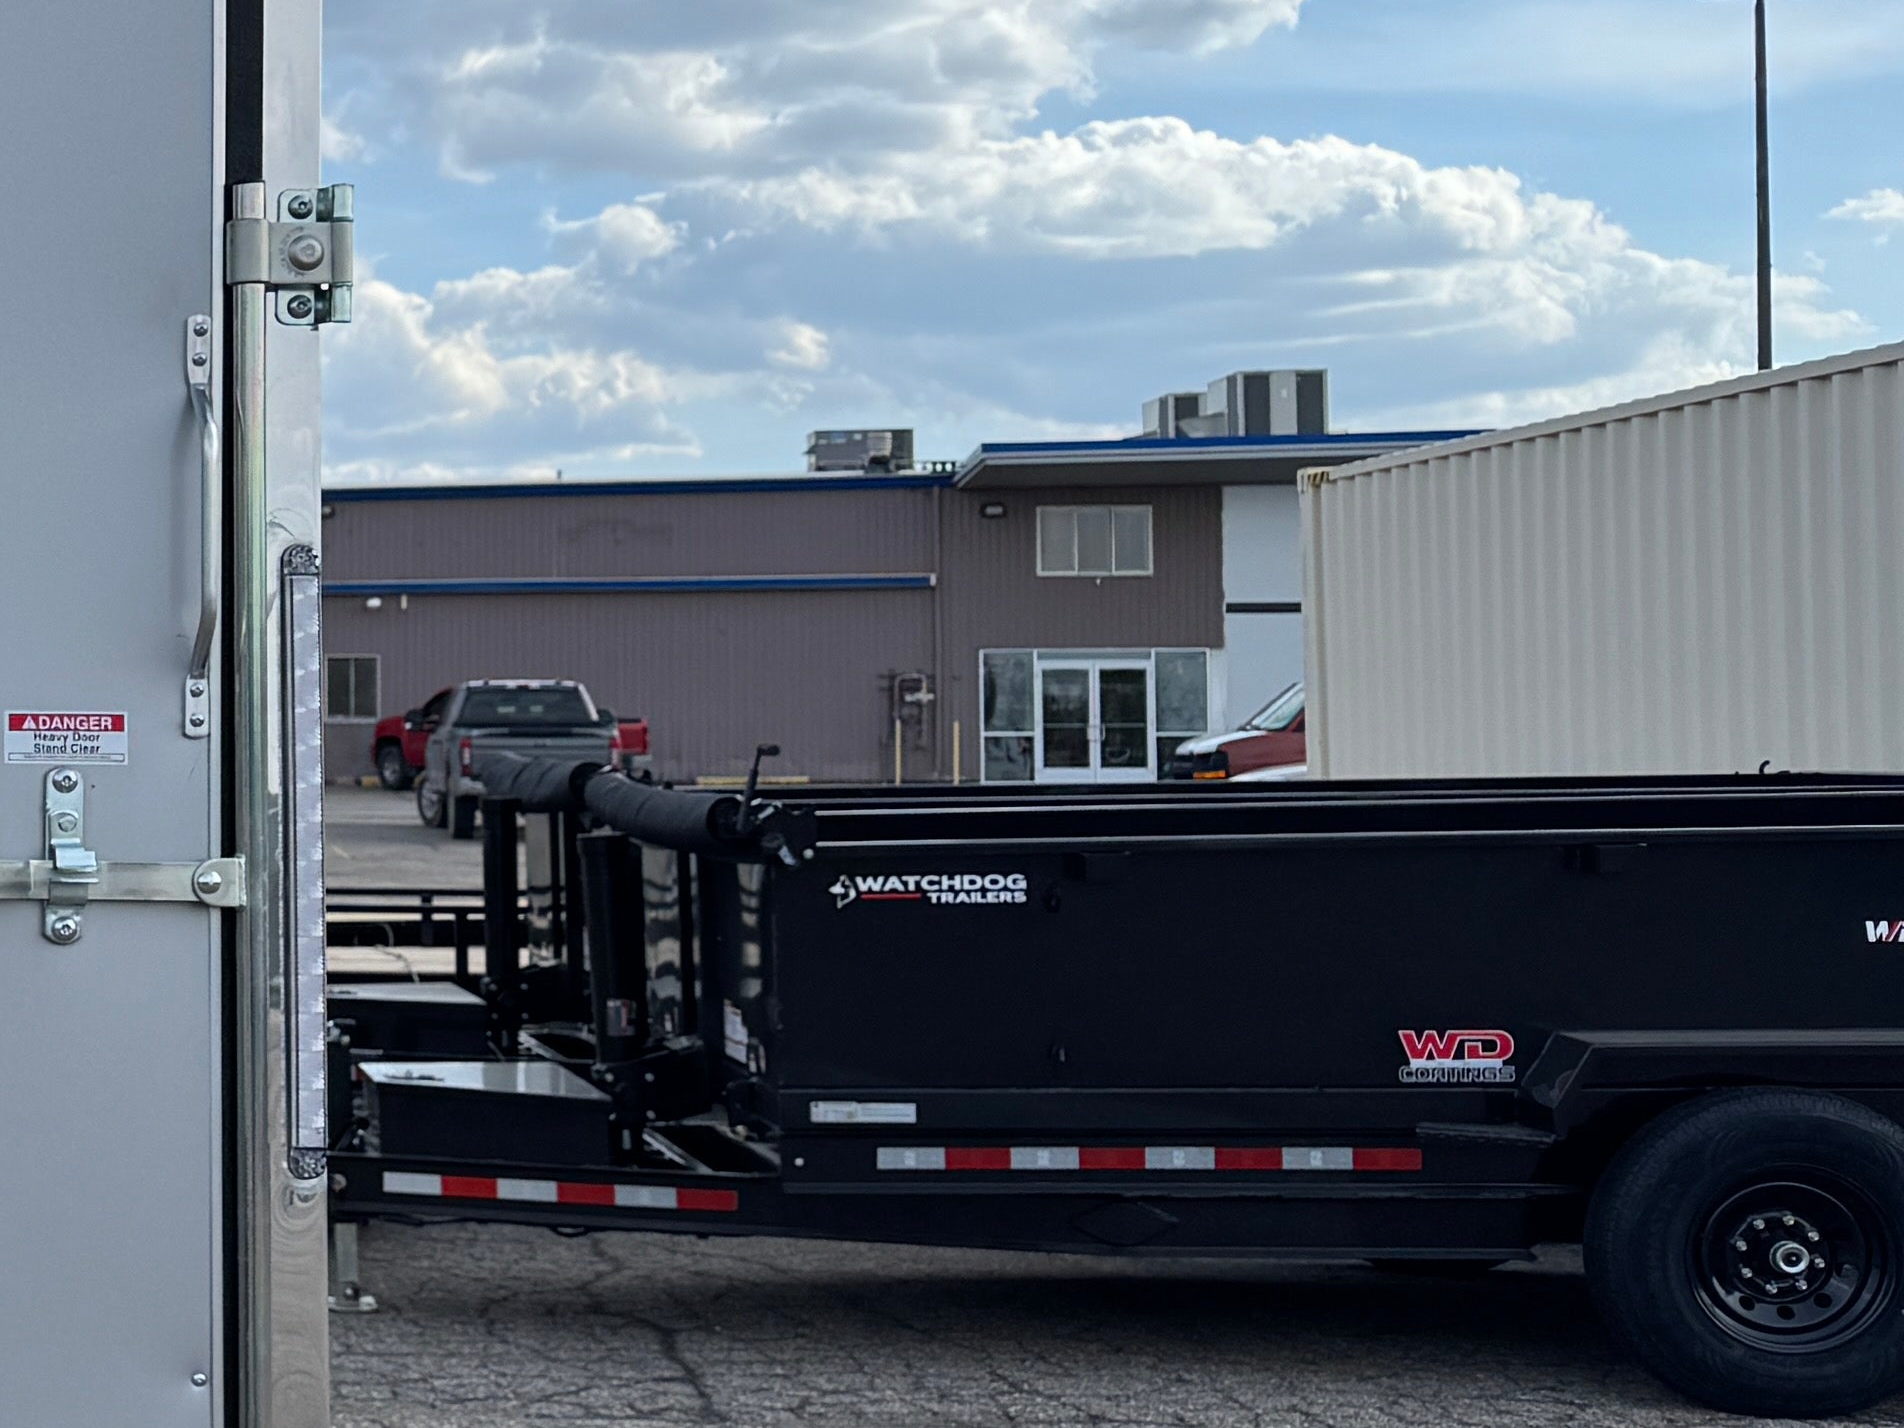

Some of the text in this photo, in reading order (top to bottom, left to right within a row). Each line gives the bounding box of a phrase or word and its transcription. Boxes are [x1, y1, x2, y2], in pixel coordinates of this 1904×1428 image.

[38, 716, 112, 730] DANGER
[34, 732, 100, 745] Heavy Door
[34, 743, 100, 754] Stand Clear
[855, 874, 1027, 892] WATCHDOG
[926, 891, 1027, 904] TRAILERS
[1398, 1029, 1514, 1061] WD
